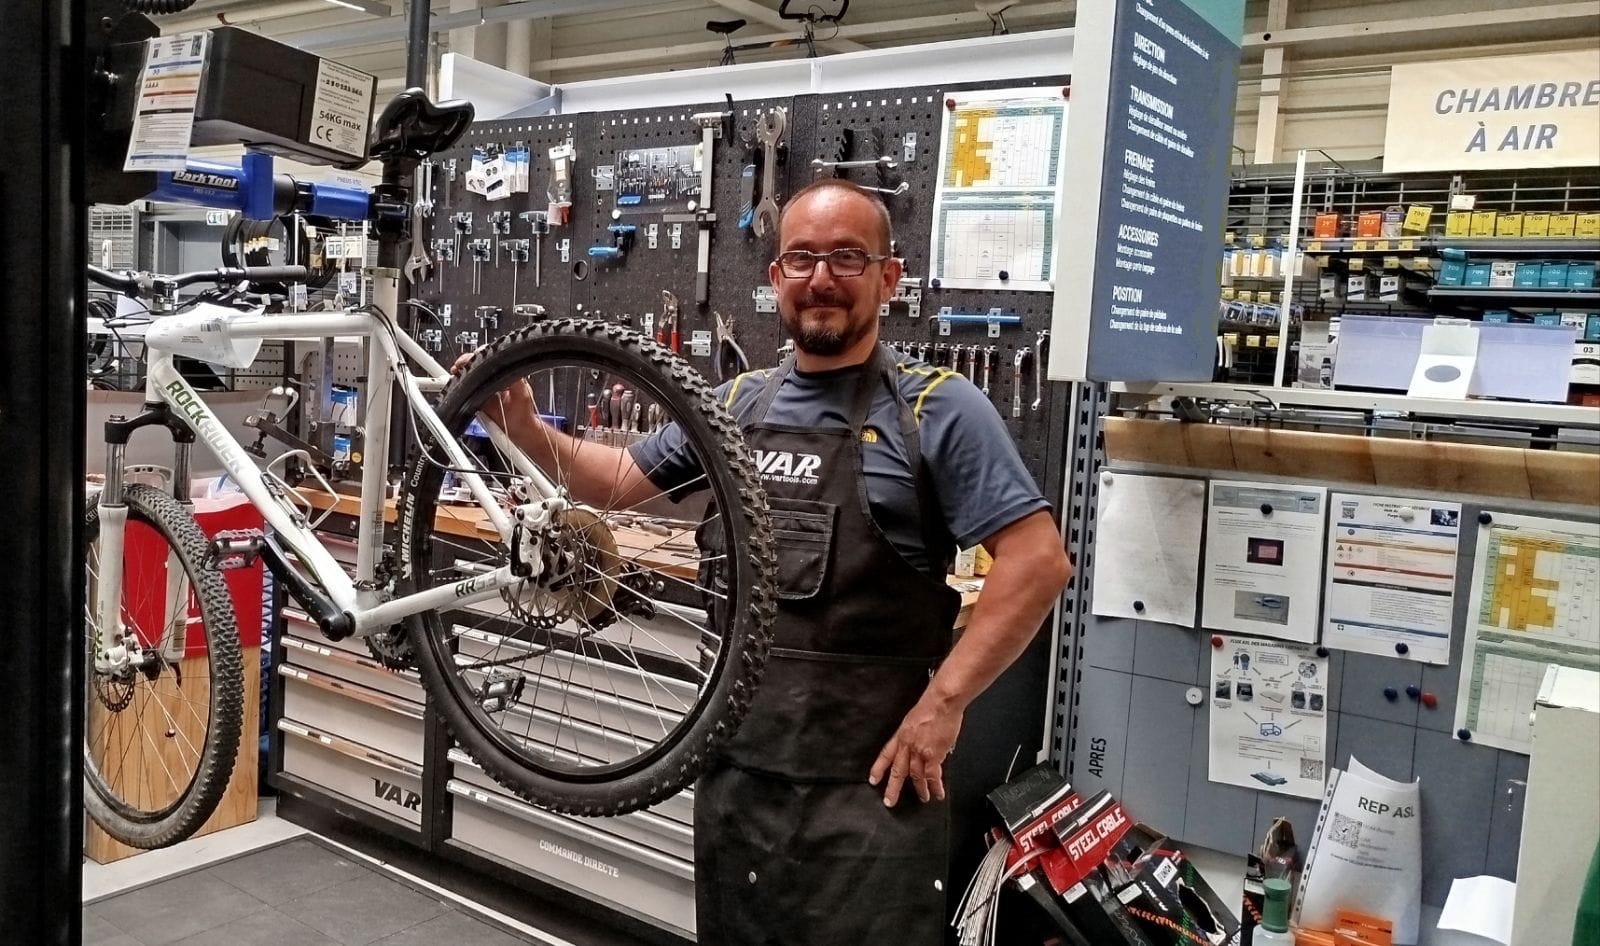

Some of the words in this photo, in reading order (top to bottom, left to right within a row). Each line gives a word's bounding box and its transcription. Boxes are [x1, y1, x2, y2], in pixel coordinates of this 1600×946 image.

[1133, 32, 1166, 64] DIRECTION
[1130, 84, 1174, 120] TRANSMISSION
[1436, 80, 1600, 115] CHAMBRE
[319, 110, 341, 124] 54KG
[343, 119, 361, 131] max
[1465, 121, 1486, 152] À
[1497, 124, 1558, 151] AIR
[1124, 148, 1155, 174] FREINAGE
[173, 168, 207, 184] Park
[207, 174, 238, 188] Tool
[1118, 224, 1160, 247] ACCESSOIRES
[1112, 285, 1143, 303] POSITION
[753, 450, 822, 478] VAR
[401, 493, 415, 562] MICHELIN
[1088, 737, 1106, 778] APRES
[371, 777, 422, 811] VAR
[1358, 796, 1389, 815] REP
[1068, 829, 1100, 861] STEEL
[1095, 806, 1126, 839] CABLE
[539, 839, 583, 865] COMMANDE
[583, 856, 619, 878] DIRECTE
